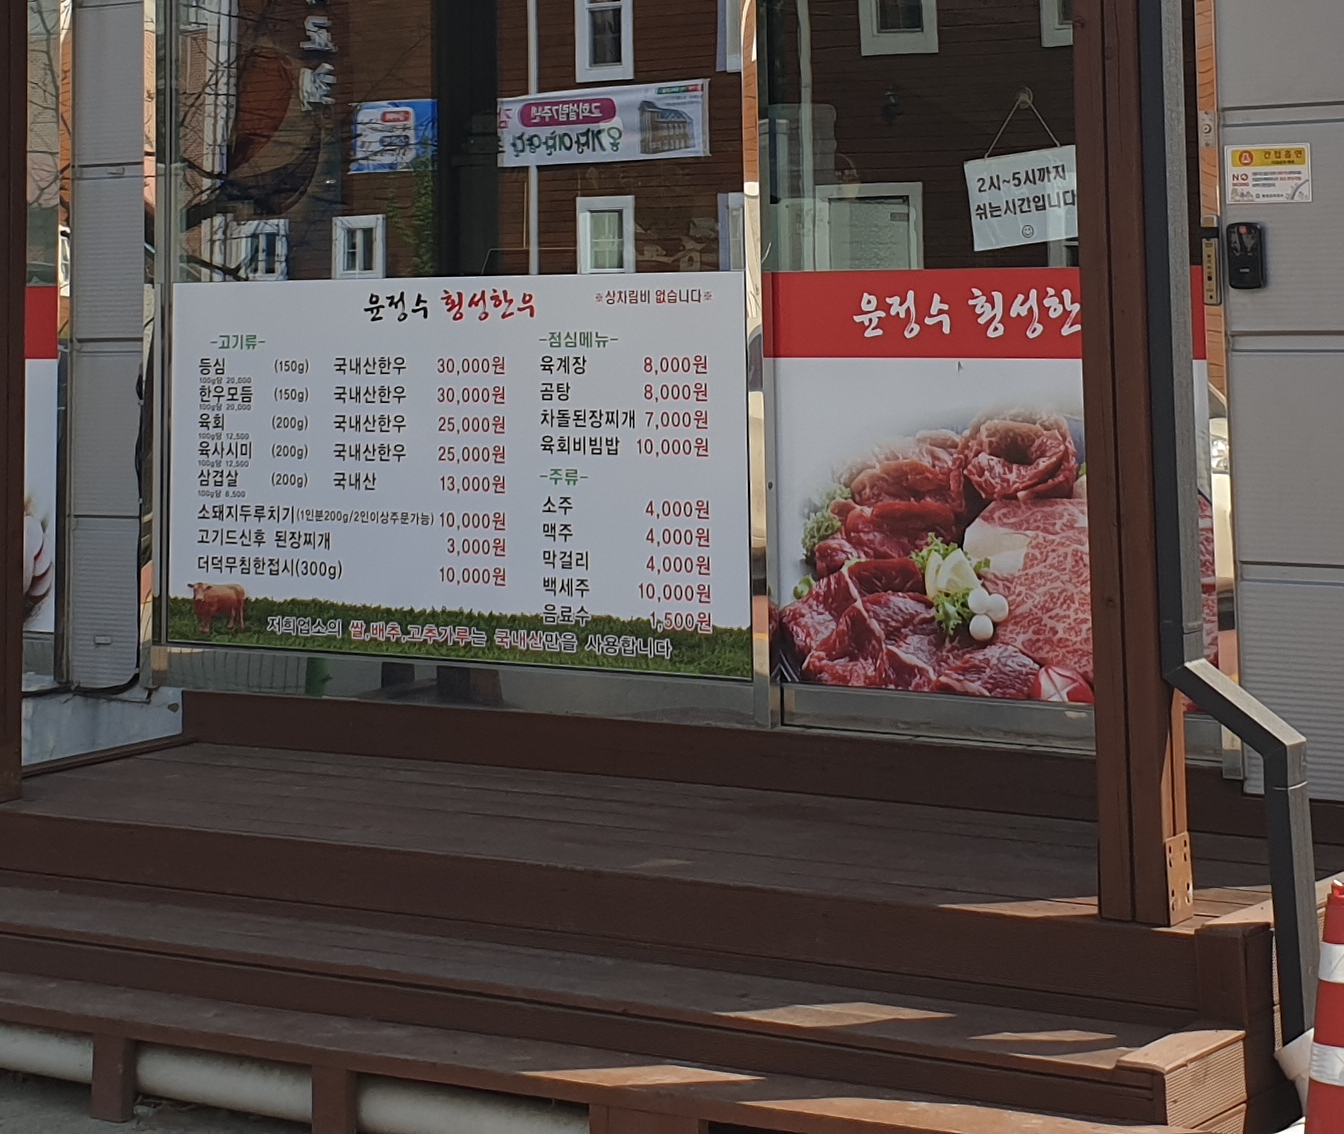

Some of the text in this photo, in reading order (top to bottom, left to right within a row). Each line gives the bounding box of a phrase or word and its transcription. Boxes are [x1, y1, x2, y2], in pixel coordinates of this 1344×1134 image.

[976, 164, 1066, 193] 2시~5시까지
[975, 189, 1076, 220] 쉬는시간입니다
[364, 288, 538, 322] 윤정수 횡성한우
[853, 289, 951, 338] 윤정수
[199, 356, 506, 376] 등심 (150g) 국내산한우 30,000원
[540, 355, 708, 375] 육계장 8,000원
[199, 385, 506, 405] 한우모듬 (150g) 국내산한우 30,000원
[540, 382, 708, 403] 곰탕 8,000원
[198, 412, 506, 435] 육회 (200g) 국내산한우 25,000원
[540, 409, 709, 430] 차돌된장찌개 7,000원
[198, 441, 506, 464] 육사시미 (200g) 국내산한우 25,000원
[540, 435, 709, 457] 육회비빔밥 10,000원
[197, 469, 506, 494] 삼겹살 (200g) 국내산 13,000원
[542, 495, 710, 520] 소주 4,000원
[439, 512, 506, 531] 10,000원
[197, 528, 506, 557] 고기드신후 된장찌개 3,000원
[542, 523, 711, 548] 맥주 4,000원
[542, 550, 711, 576] 막걸리 4,000원
[439, 567, 506, 587] 10,000원
[543, 577, 712, 604] 백세주 10,000원
[542, 604, 713, 634] 음료수 1,500원
[266, 616, 343, 638] 저희업소의
[494, 627, 577, 652] 국내산만을
[585, 634, 673, 659] 사용합니다
